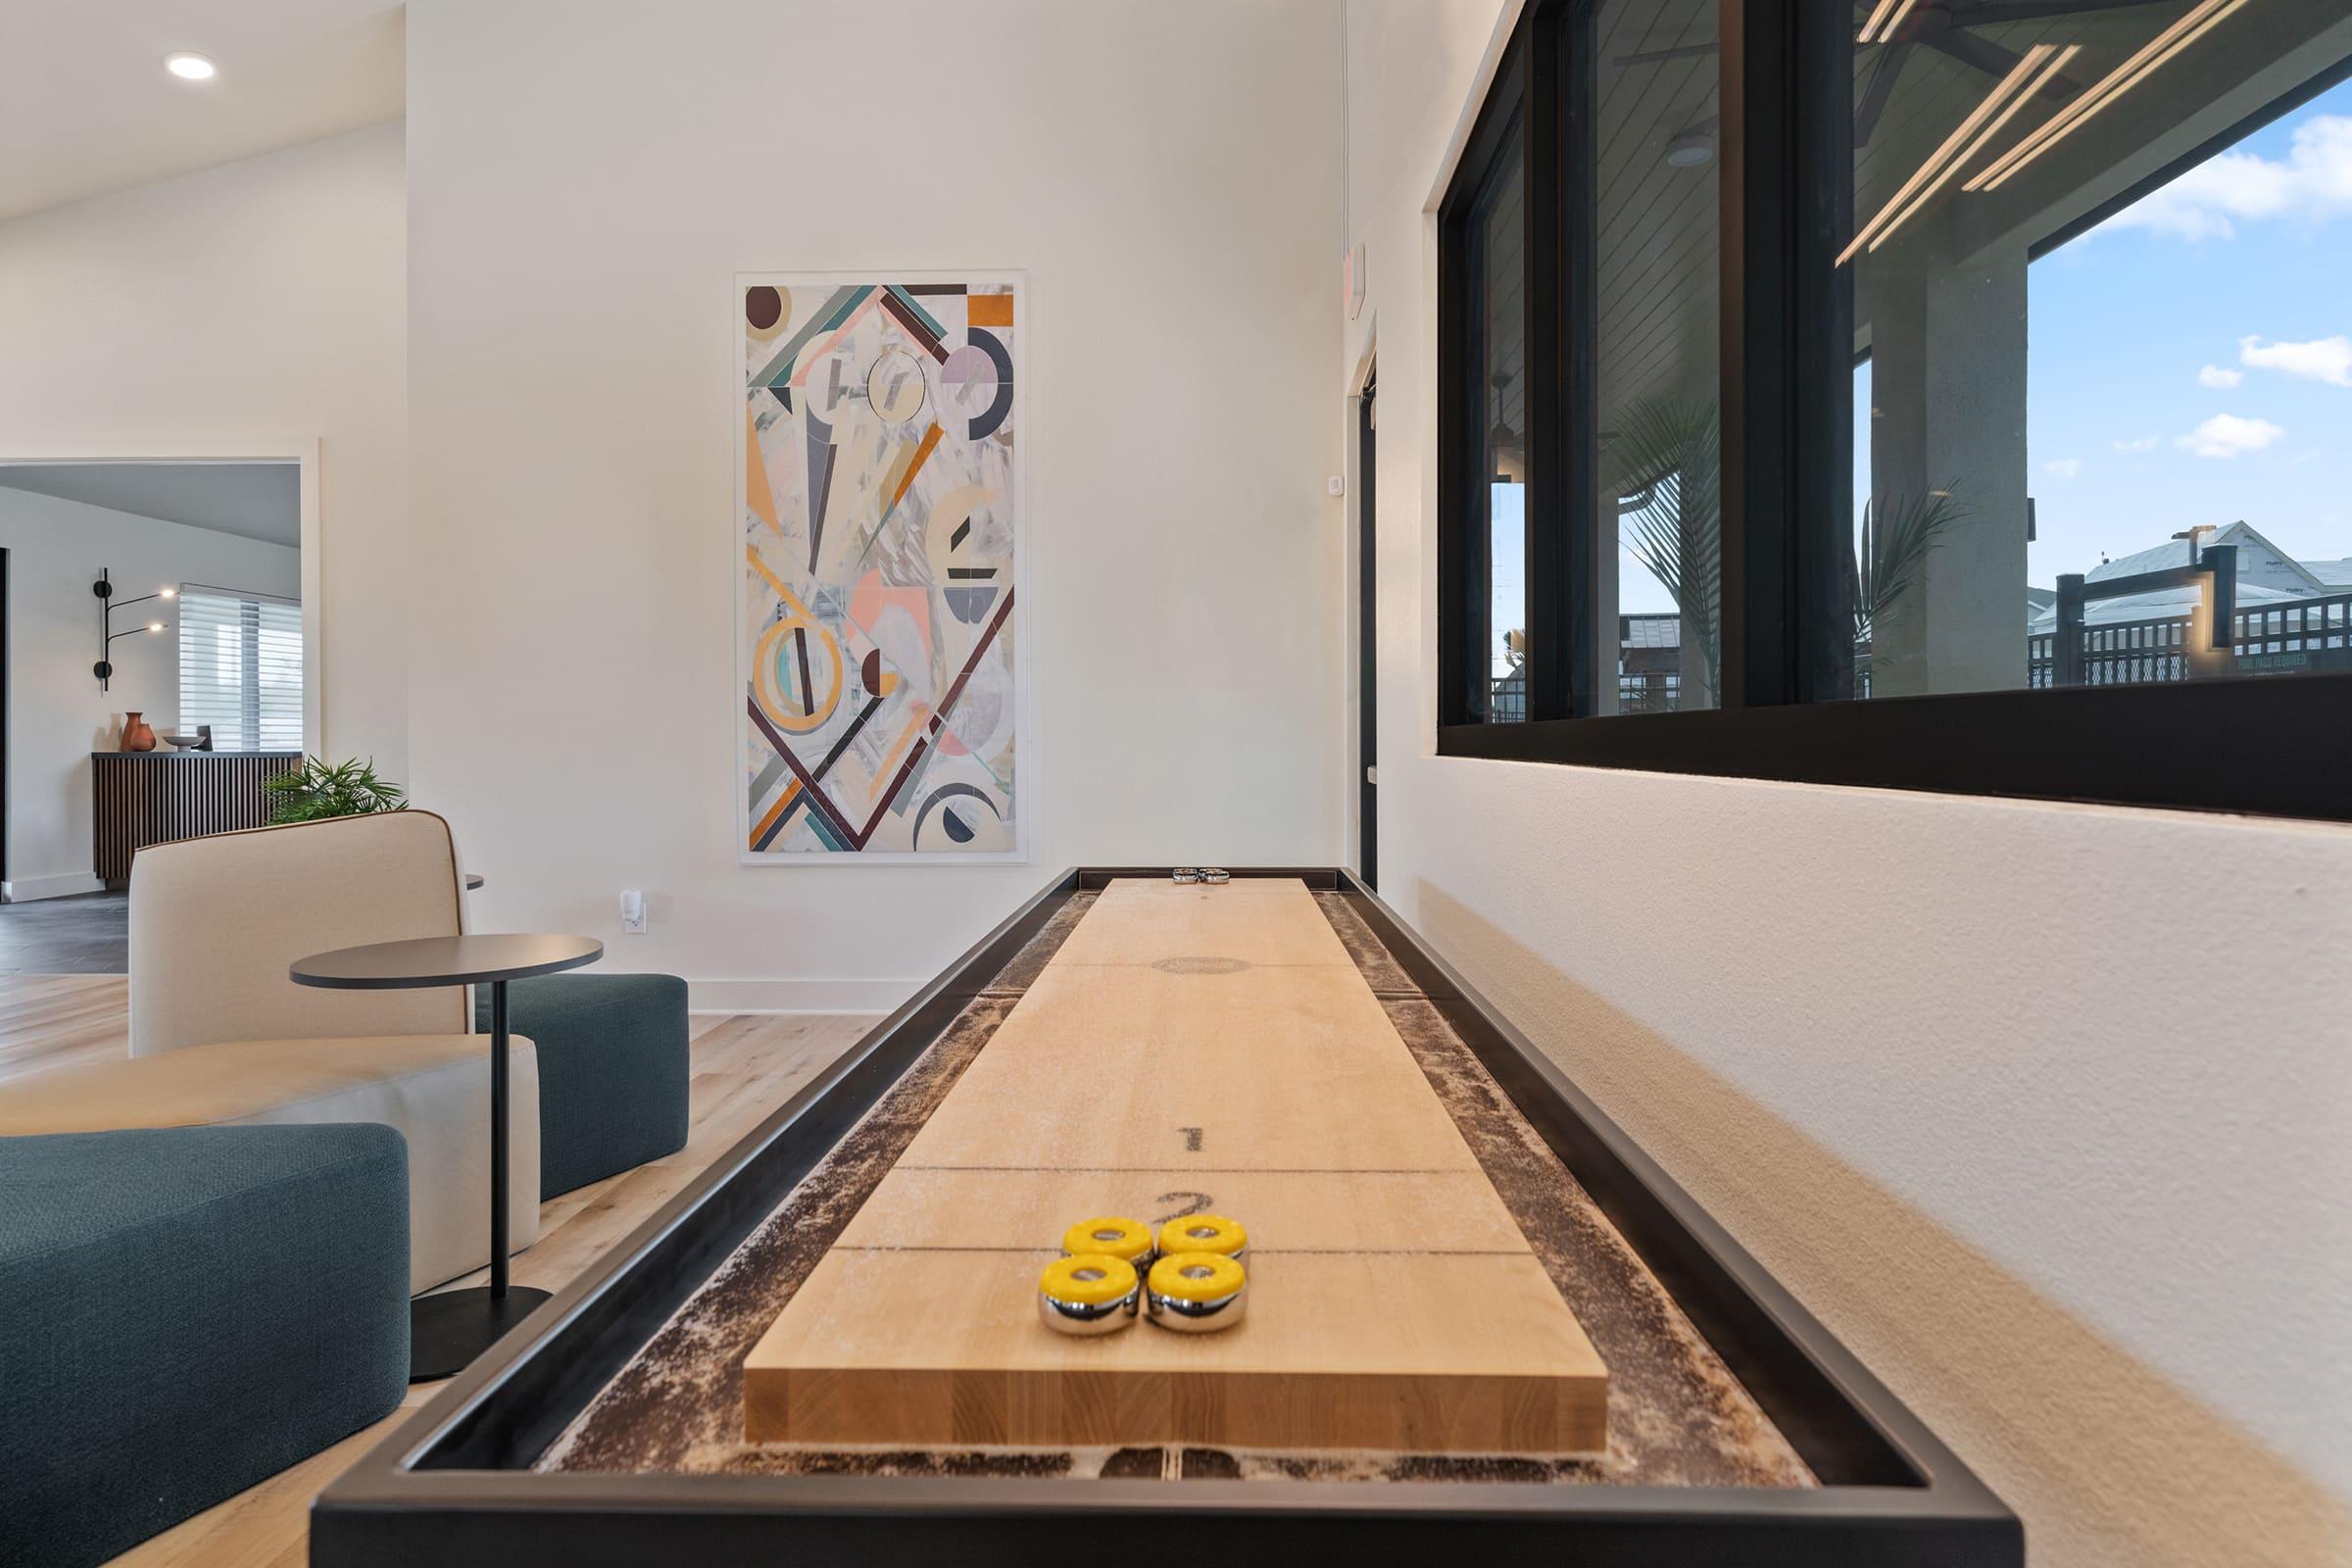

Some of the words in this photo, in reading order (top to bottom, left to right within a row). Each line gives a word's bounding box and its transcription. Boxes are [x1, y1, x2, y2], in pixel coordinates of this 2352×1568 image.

[2256, 657, 2272, 668] PASS
[2274, 654, 2306, 667] REQUIRED
[1176, 1127, 1204, 1152] 1
[1152, 1191, 1214, 1225] 2
